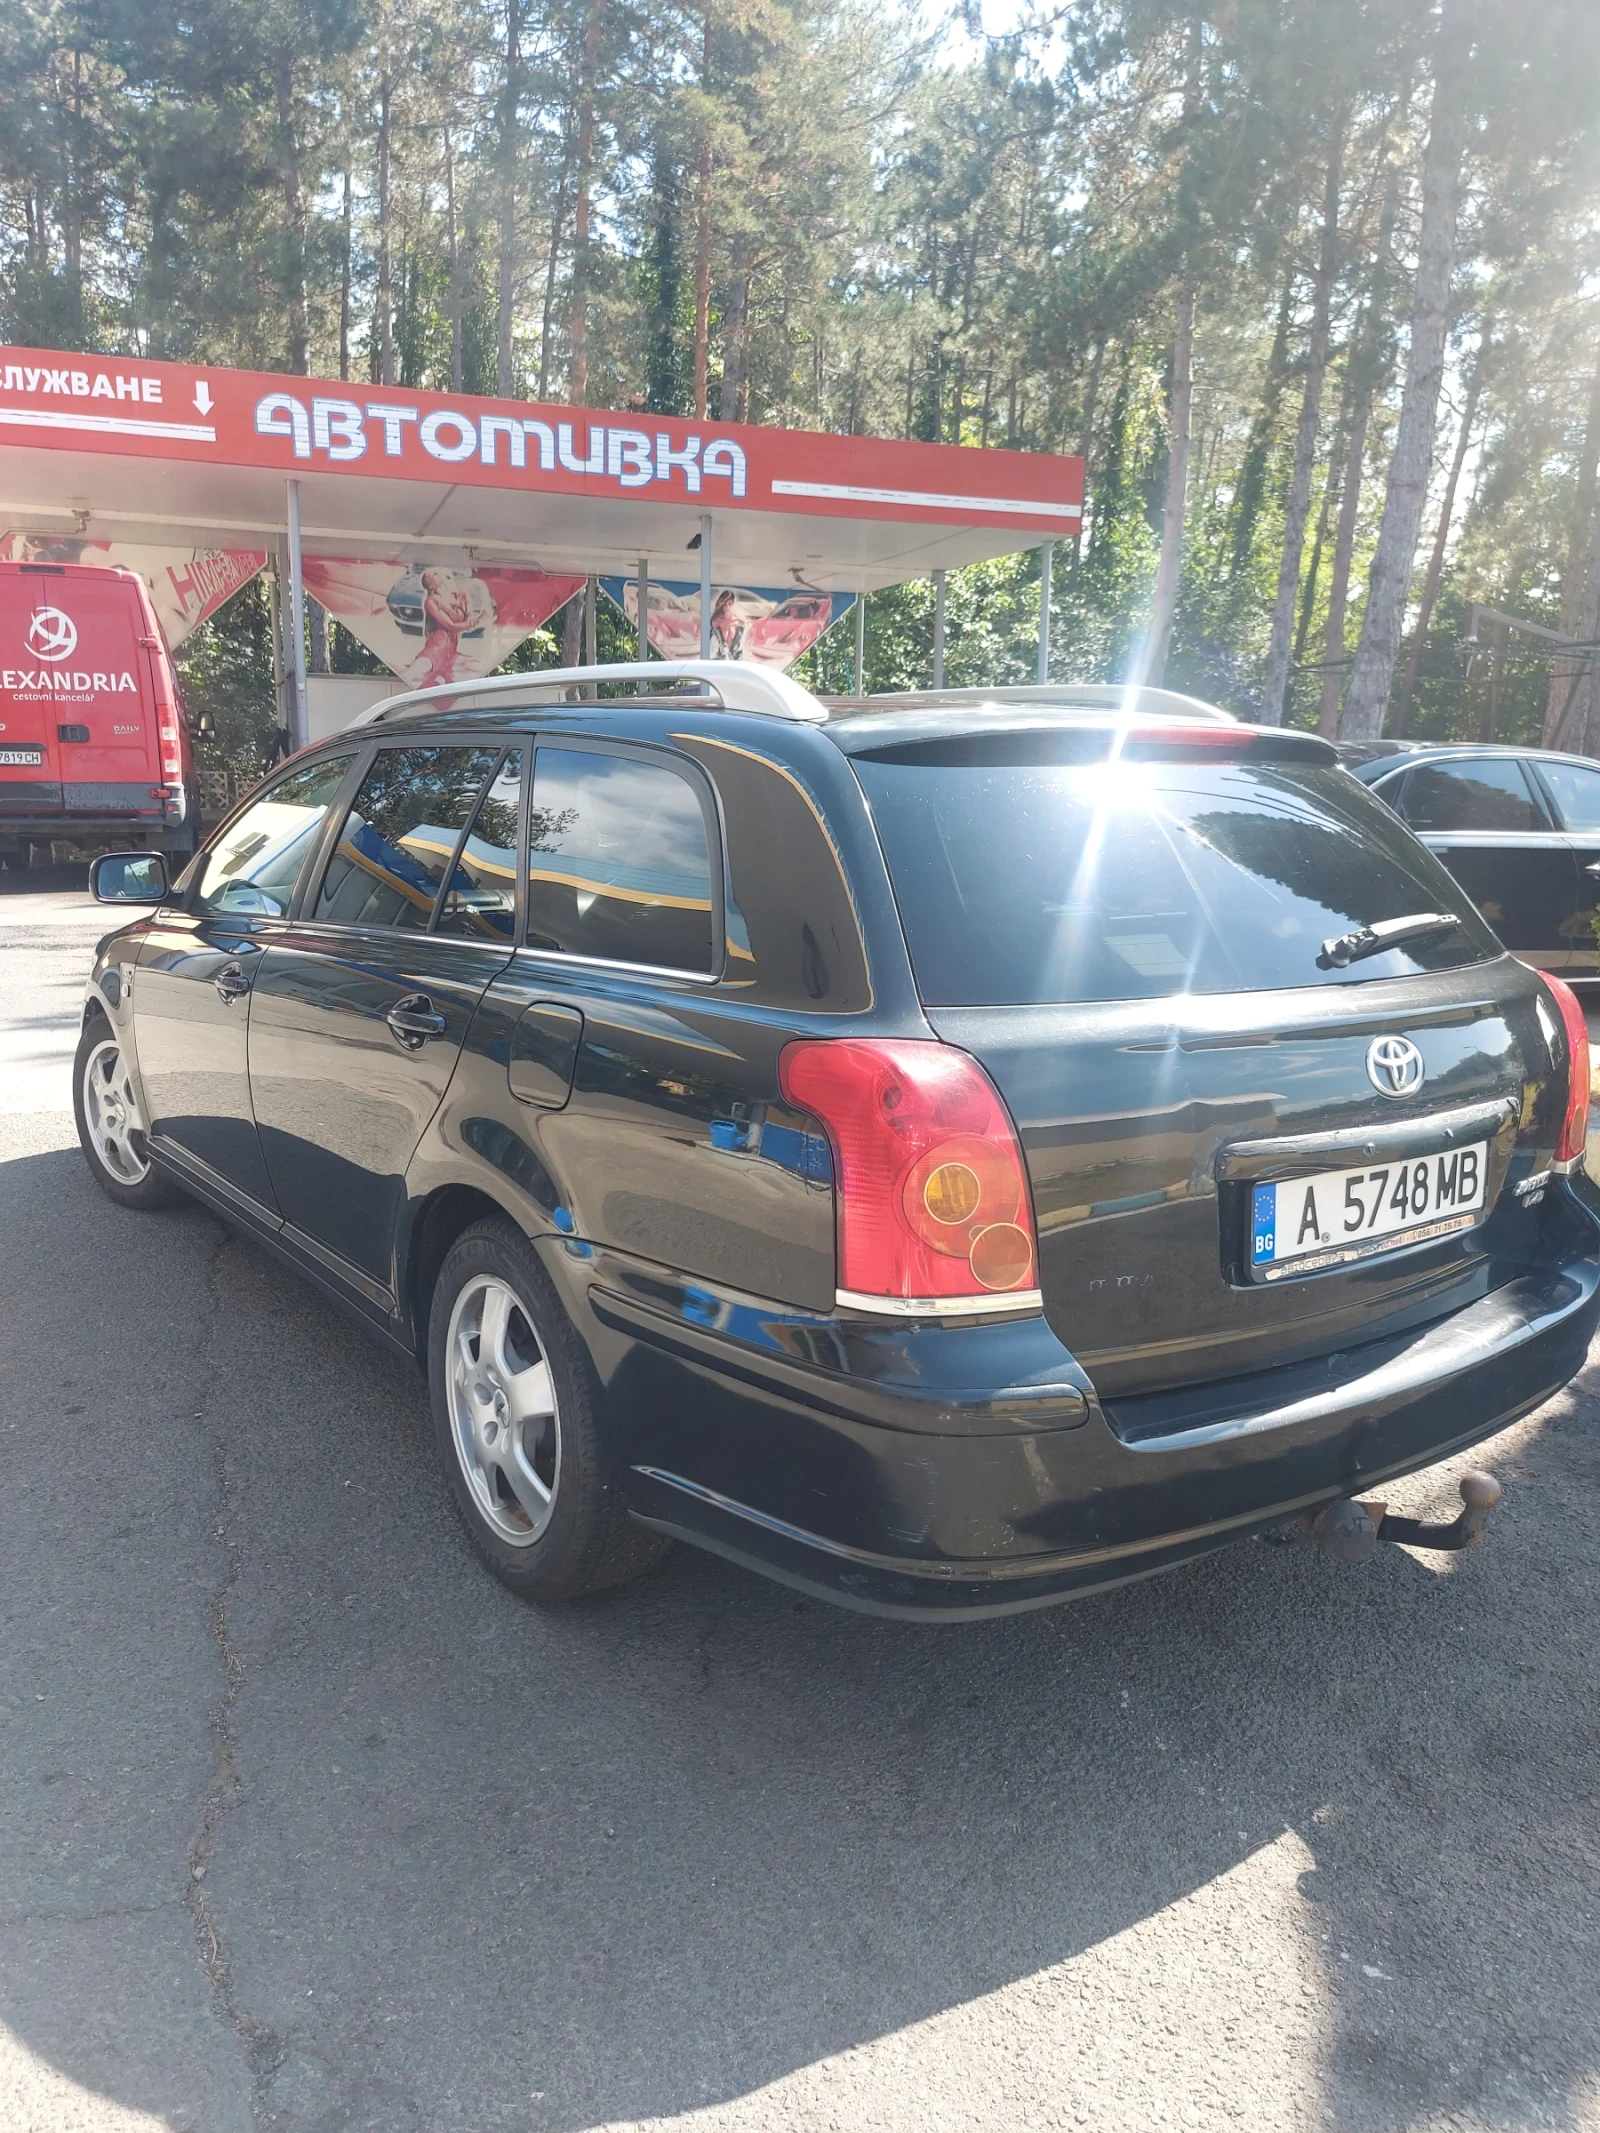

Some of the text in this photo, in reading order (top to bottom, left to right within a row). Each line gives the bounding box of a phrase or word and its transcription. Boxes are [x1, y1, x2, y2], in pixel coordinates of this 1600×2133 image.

[0, 670, 137, 692] EXANDRIA
[13, 692, 95, 702] cestovní kancelář
[1297, 1186, 1320, 1245] A
[1344, 1161, 1429, 1231] 5748
[1435, 1150, 1478, 1210] MB
[1255, 1233, 1274, 1253] BG
